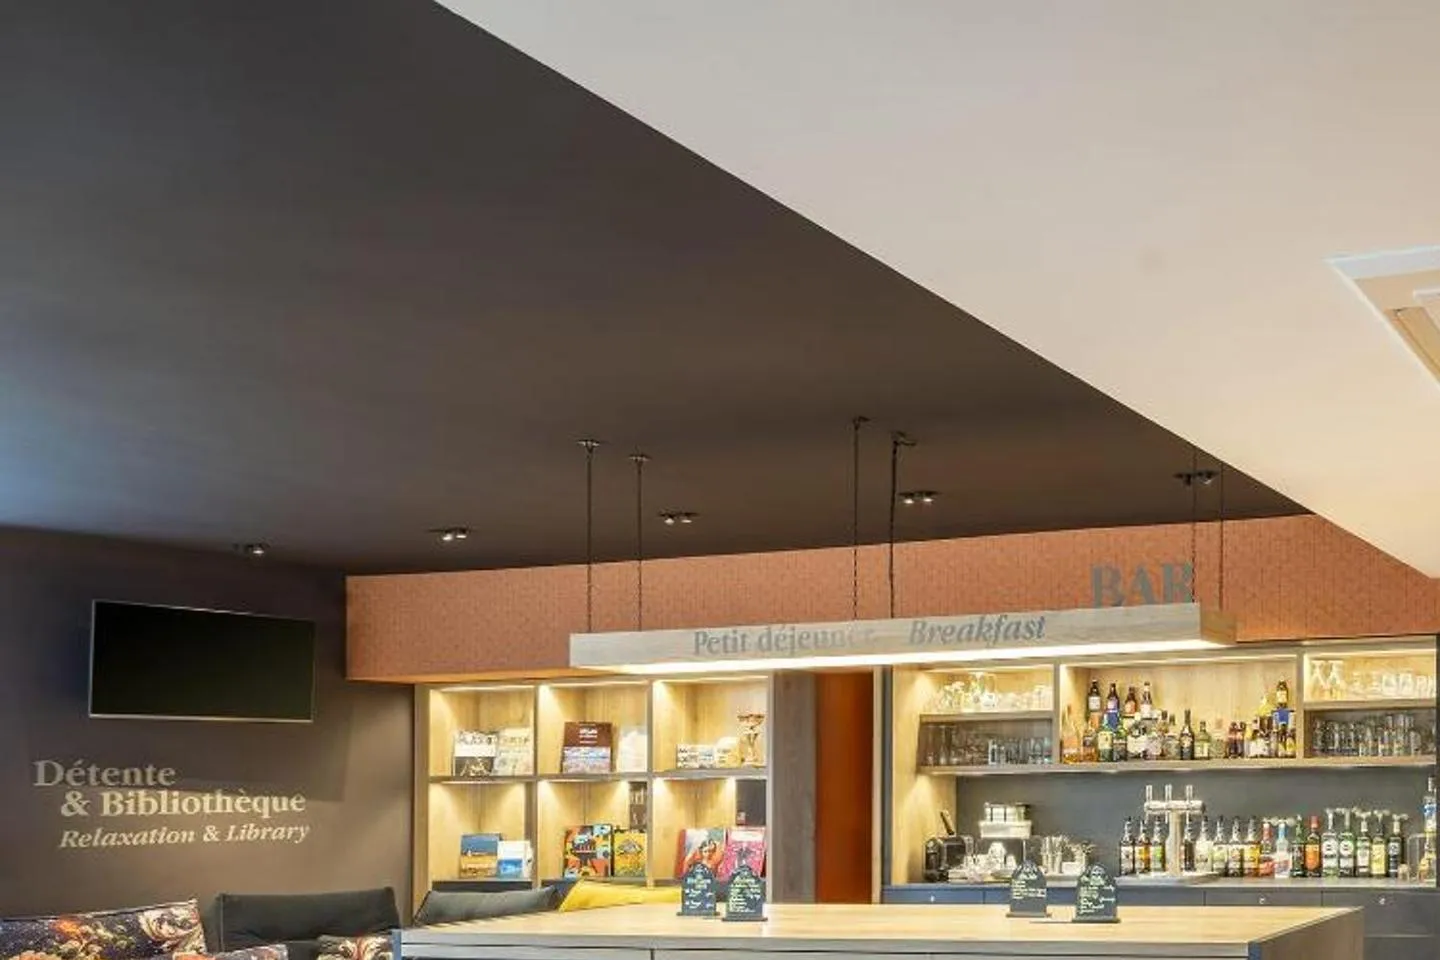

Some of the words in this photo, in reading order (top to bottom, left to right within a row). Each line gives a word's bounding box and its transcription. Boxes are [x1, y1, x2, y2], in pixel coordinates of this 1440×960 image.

[1091, 563, 1192, 609] BAR
[693, 630, 748, 656] Petit
[908, 614, 1047, 647] Breakfast
[32, 759, 176, 787] Détente
[60, 790, 91, 817] &
[100, 788, 307, 819] Bibliothèque
[58, 826, 195, 848] Relaxation
[203, 824, 221, 842] &
[224, 823, 310, 844] Library
